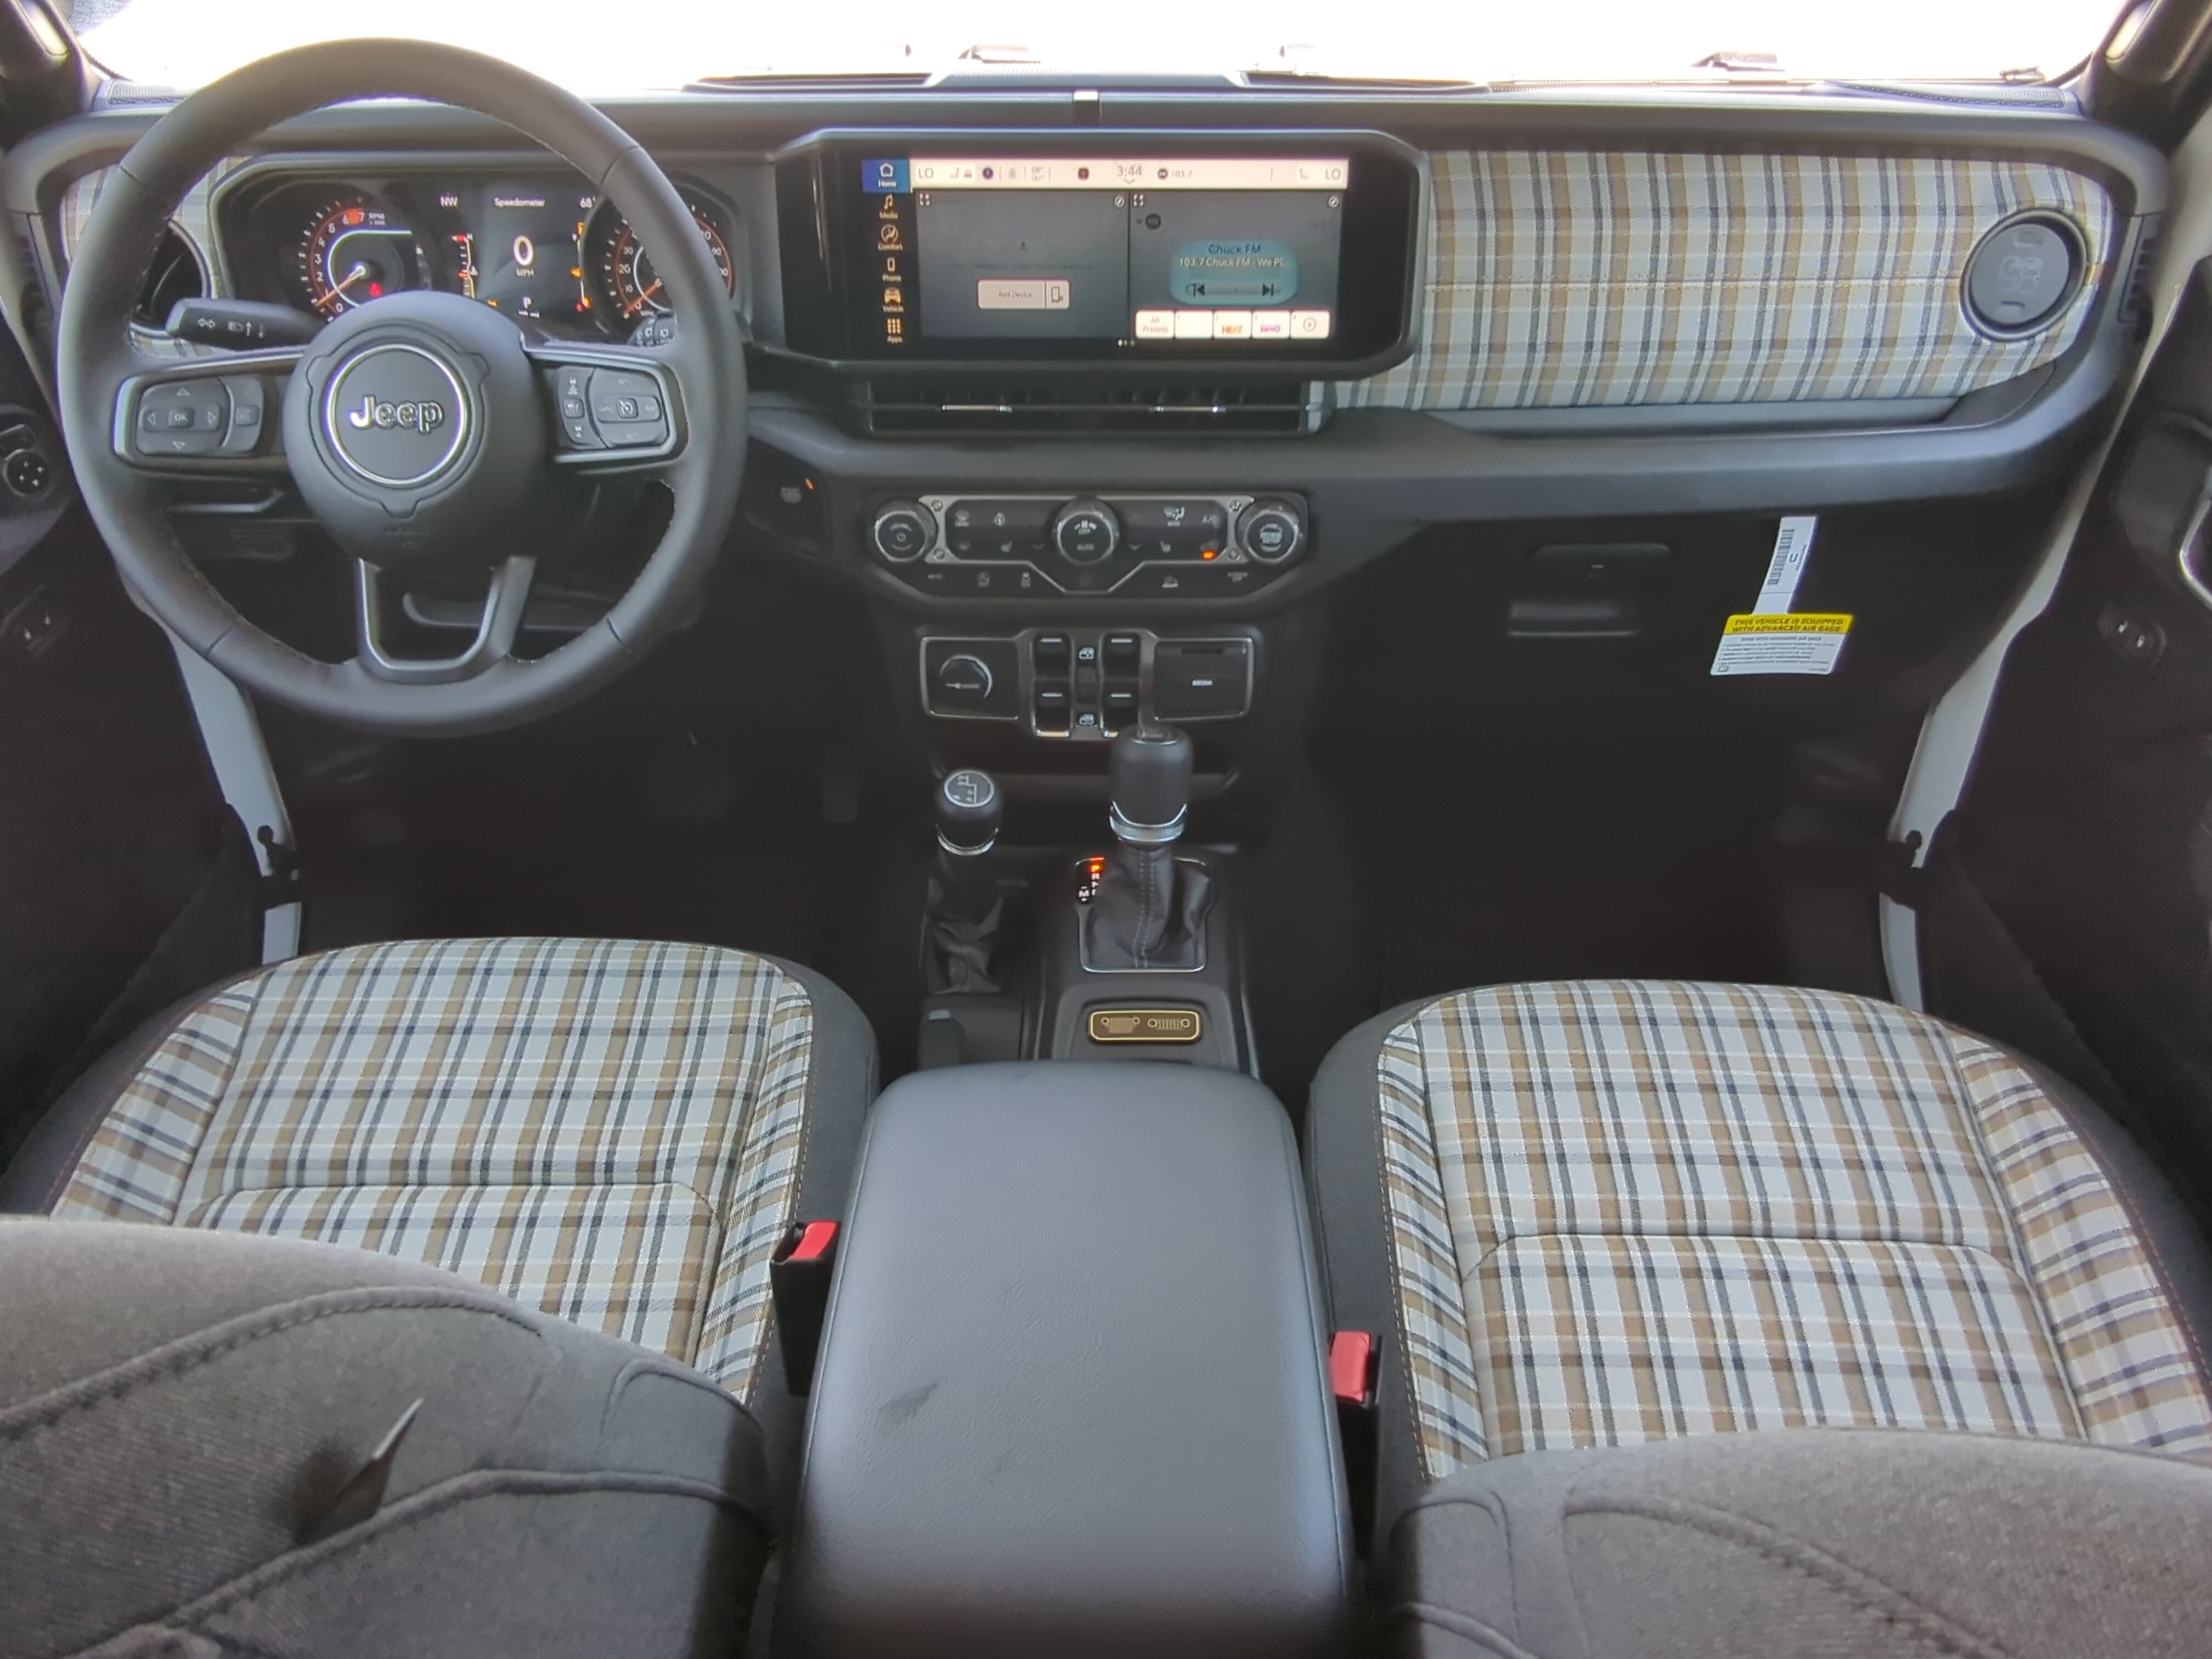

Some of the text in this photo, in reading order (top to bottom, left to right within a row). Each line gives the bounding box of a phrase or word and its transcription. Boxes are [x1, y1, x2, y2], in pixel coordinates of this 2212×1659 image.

[918, 167, 934, 179] LO
[1116, 165, 1142, 177] 3:44
[1171, 170, 1192, 178] 103.7
[1325, 168, 1341, 179] LO
[441, 197, 458, 207] NW
[494, 198, 545, 208] Speedometer
[342, 215, 349, 225] 6
[358, 212, 365, 222] 7
[329, 223, 336, 234] 5
[318, 236, 325, 247] 4
[512, 235, 534, 267] 0
[623, 246, 634, 255] 30
[1207, 244, 1261, 255] Chuck FM
[314, 253, 322, 264] 3
[1179, 258, 1205, 267] 103.7
[1205, 258, 1235, 267] Chuck
[1235, 258, 1250, 267] FM
[1257, 258, 1273, 267] We
[516, 268, 534, 277] MPH
[618, 264, 631, 274] 20
[317, 271, 324, 282] 2
[882, 274, 901, 282] Phone
[997, 290, 1010, 298] Add
[336, 303, 343, 313] 0
[523, 297, 532, 310] P
[1222, 325, 1244, 335] HEAT
[887, 335, 903, 344] Apps
[174, 414, 188, 422] OK
[349, 394, 444, 435] Jeep
